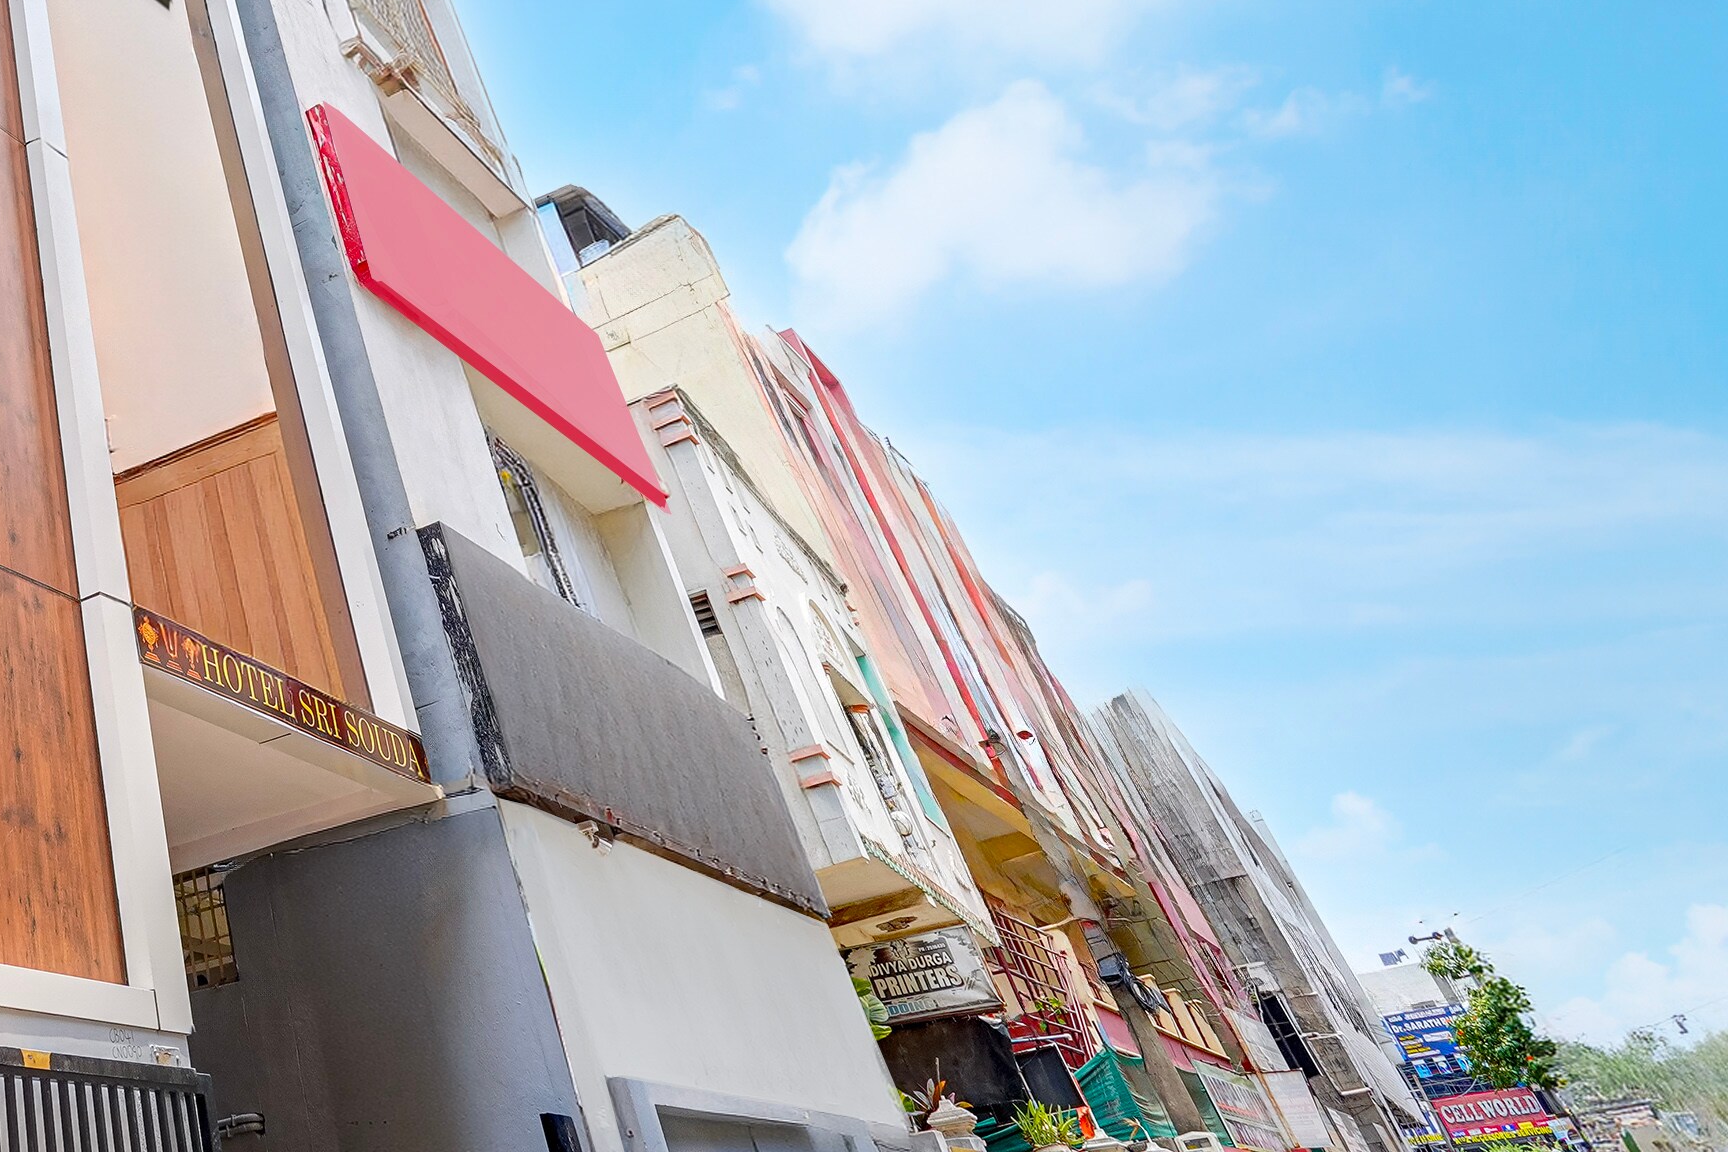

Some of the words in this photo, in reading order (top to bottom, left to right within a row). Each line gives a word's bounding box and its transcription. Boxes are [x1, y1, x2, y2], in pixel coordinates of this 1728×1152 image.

[200, 644, 296, 720] HOTEL
[298, 688, 343, 740] SRI
[344, 710, 424, 779] SOUDA
[869, 960, 908, 977] DIVYA
[908, 951, 953, 970] DURGA
[874, 965, 963, 998] PRINTERS
[1440, 1101, 1484, 1124] CELL
[1477, 1094, 1543, 1118] WORLD
